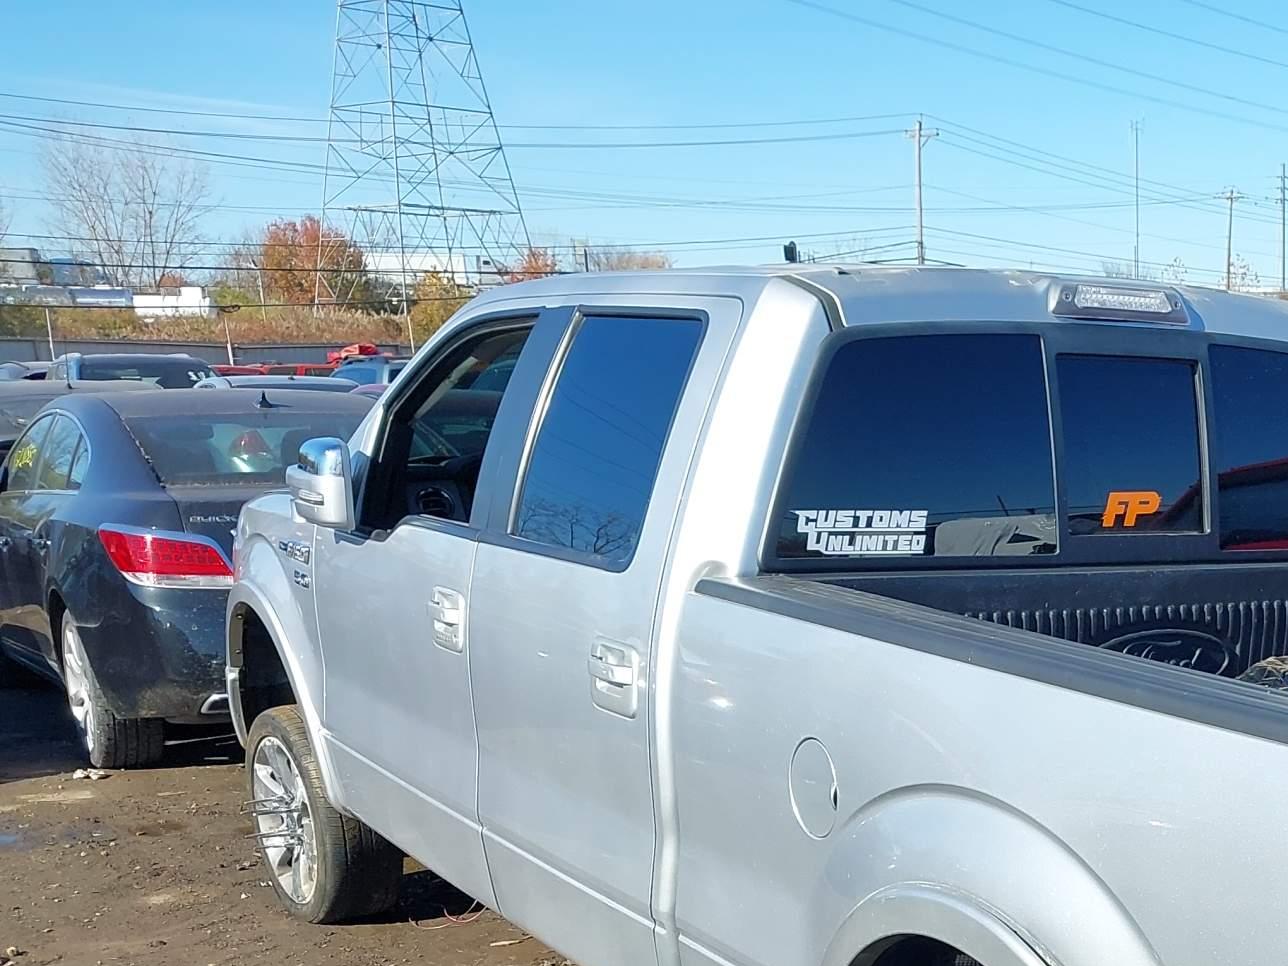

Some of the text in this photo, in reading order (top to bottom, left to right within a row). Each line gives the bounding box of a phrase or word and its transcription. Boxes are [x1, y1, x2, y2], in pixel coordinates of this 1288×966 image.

[790, 509, 928, 532] CUSTOMS
[1102, 491, 1161, 527] FP
[806, 531, 927, 554] UNLIMITED
